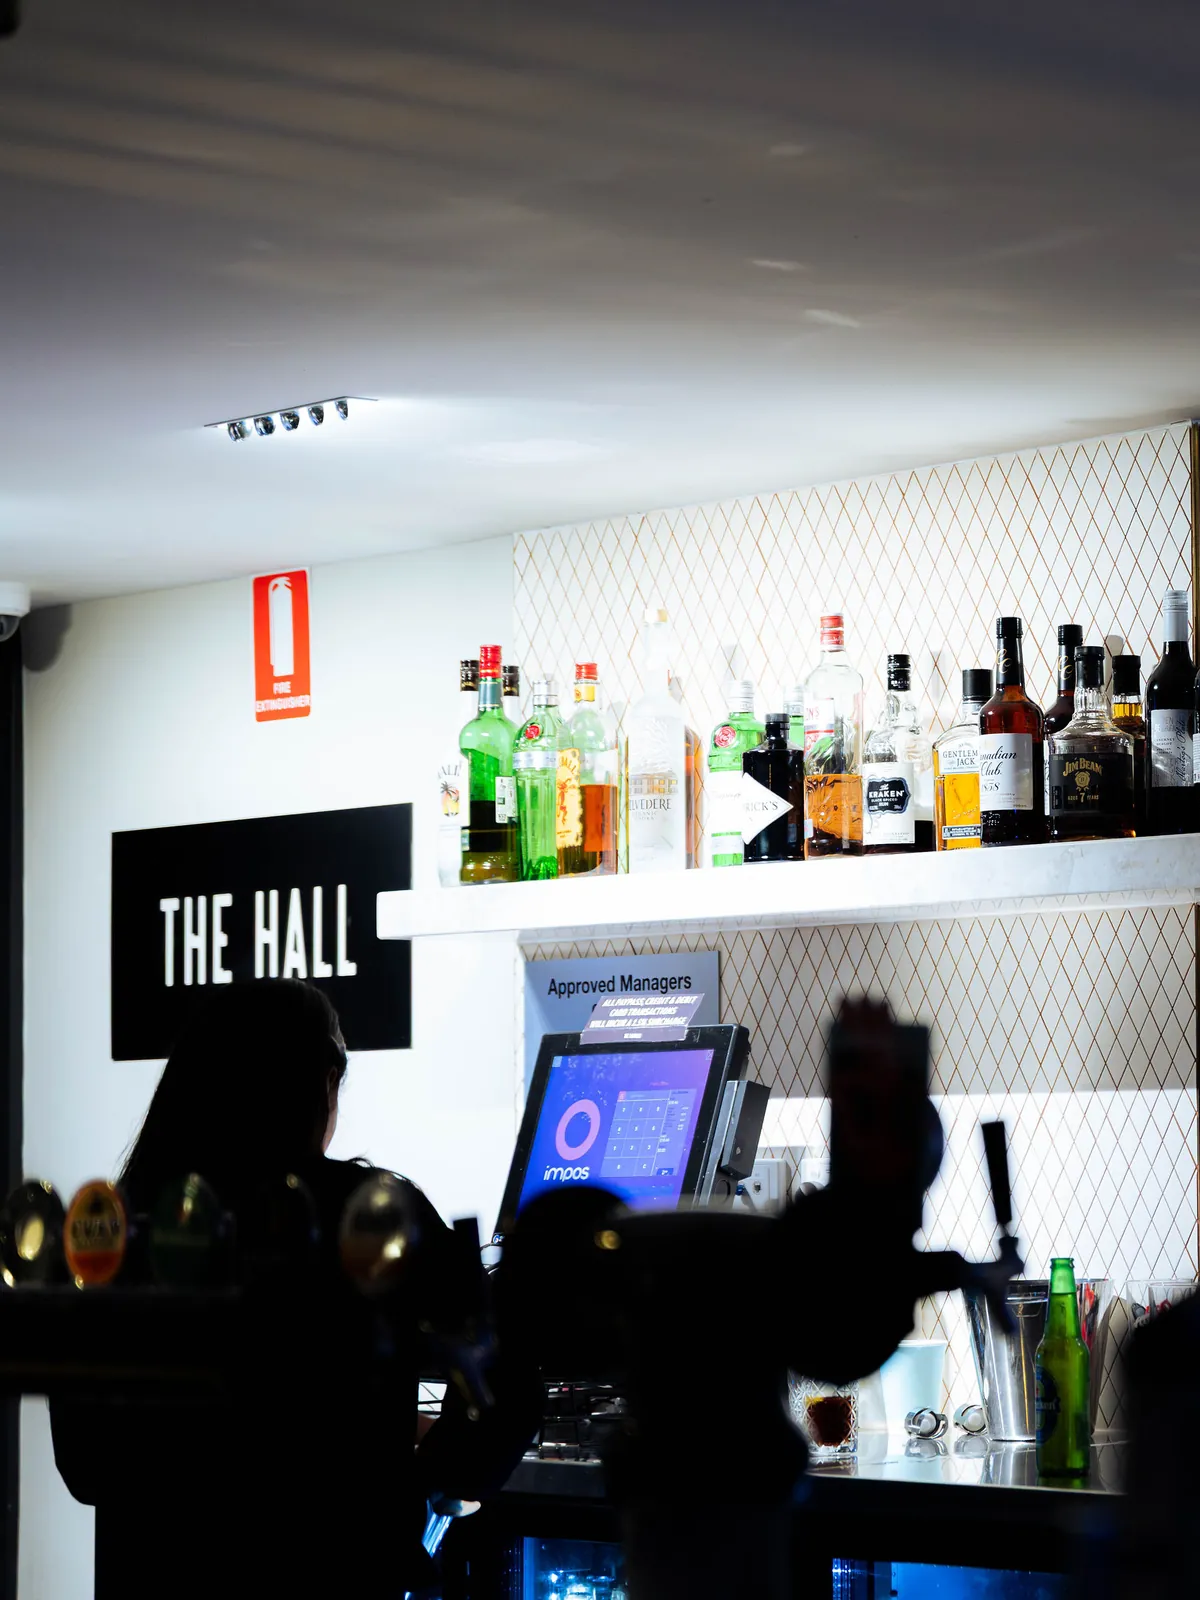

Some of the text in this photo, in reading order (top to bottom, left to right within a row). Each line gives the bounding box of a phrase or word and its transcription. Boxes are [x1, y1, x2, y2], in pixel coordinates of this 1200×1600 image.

[273, 681, 291, 695] FIRE
[255, 694, 311, 713] EXTINGUISHER
[942, 749, 979, 759] GENTLEM
[956, 757, 976, 767] JACK
[1062, 757, 1103, 777] JIM BEAM
[868, 790, 904, 798] KRAKEN
[1080, 792, 1086, 803] 7
[629, 798, 672, 811] ELVEDERE
[159, 883, 358, 987] THE HALL
[548, 974, 692, 999] Approved Managers
[601, 999, 616, 1007] ALL
[645, 996, 669, 1006] CREDIT
[675, 995, 698, 1004] DEBIT
[608, 1006, 679, 1017] CARD TRANSACTIONS
[589, 1020, 606, 1029] WILL
[605, 1019, 627, 1028] INCUR
[646, 1016, 688, 1026] SURCHARGE
[543, 1165, 590, 1182] impos
